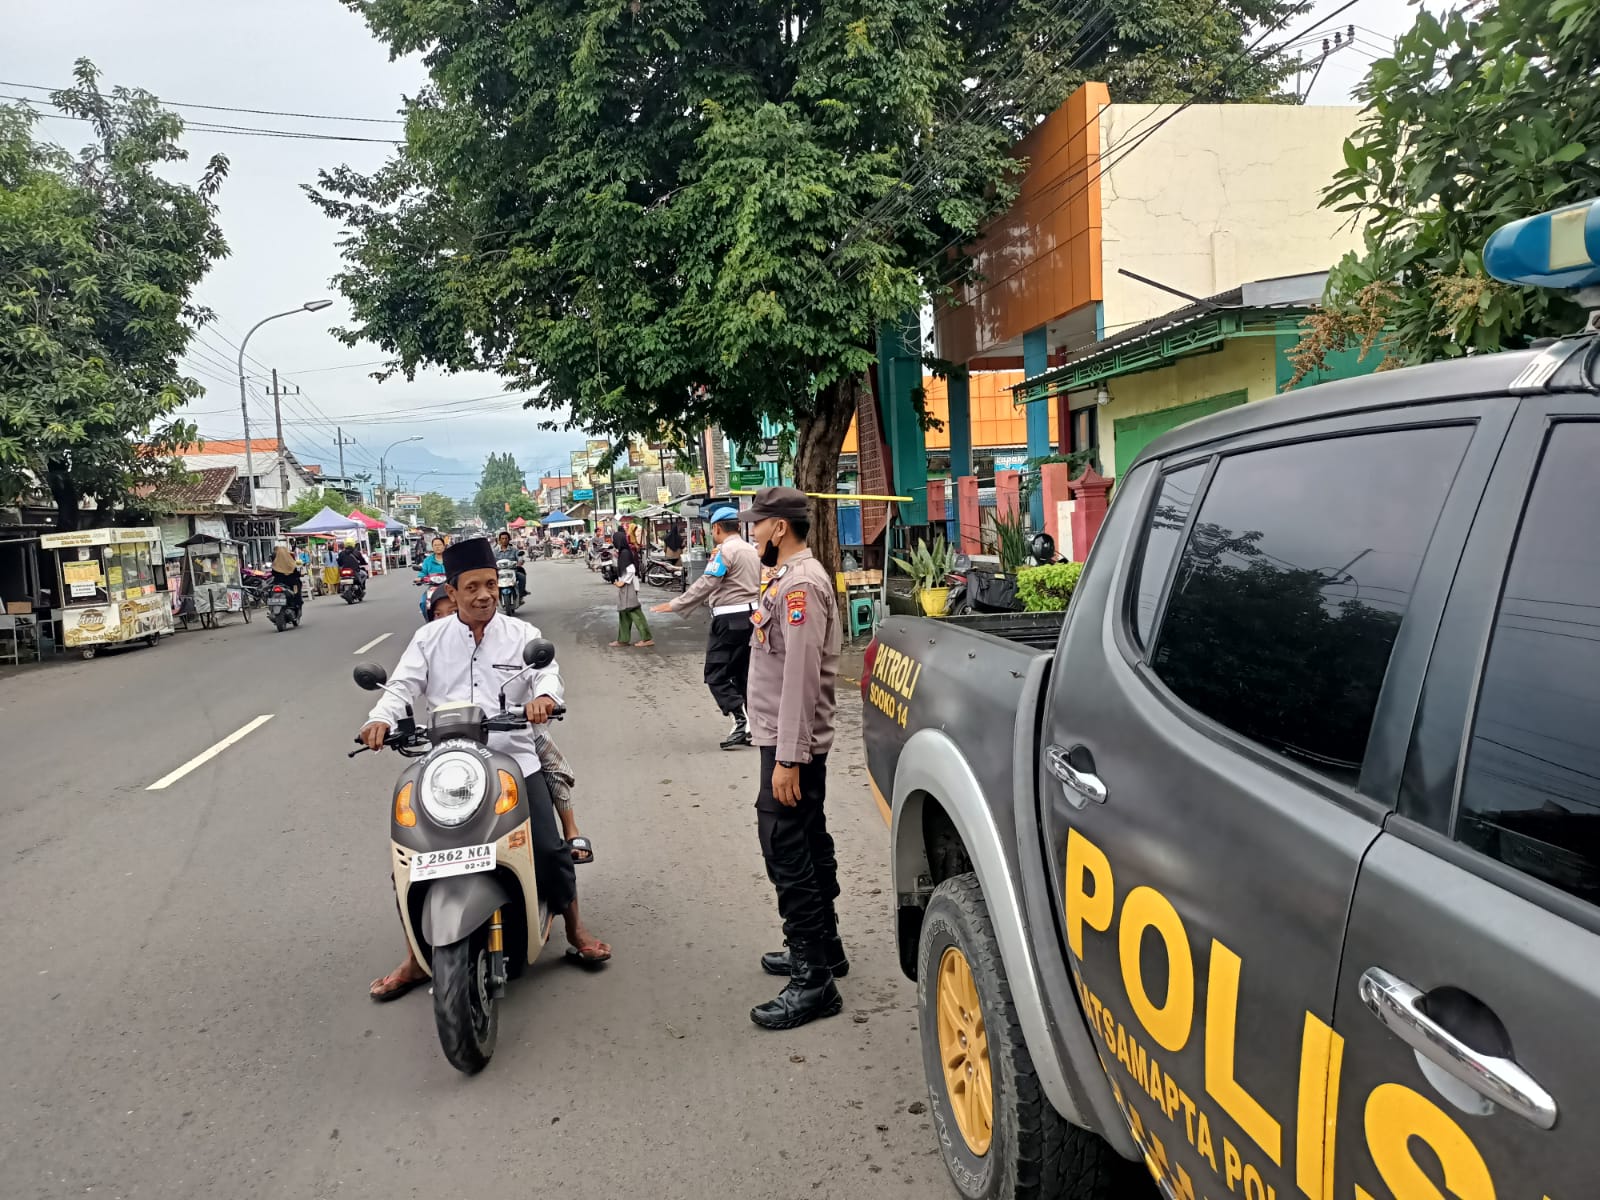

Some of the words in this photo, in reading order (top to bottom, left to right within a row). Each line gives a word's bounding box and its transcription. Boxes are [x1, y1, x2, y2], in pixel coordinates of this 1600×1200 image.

[234, 522, 245, 537] ES
[247, 521, 276, 537] DEGAN
[872, 643, 922, 700] PATROLI
[869, 682, 895, 719] SOOKO
[897, 702, 908, 728] 14
[417, 855, 424, 866] S
[428, 849, 463, 865] 2862
[468, 845, 491, 859] NCA
[1066, 827, 1558, 1200] POLIS
